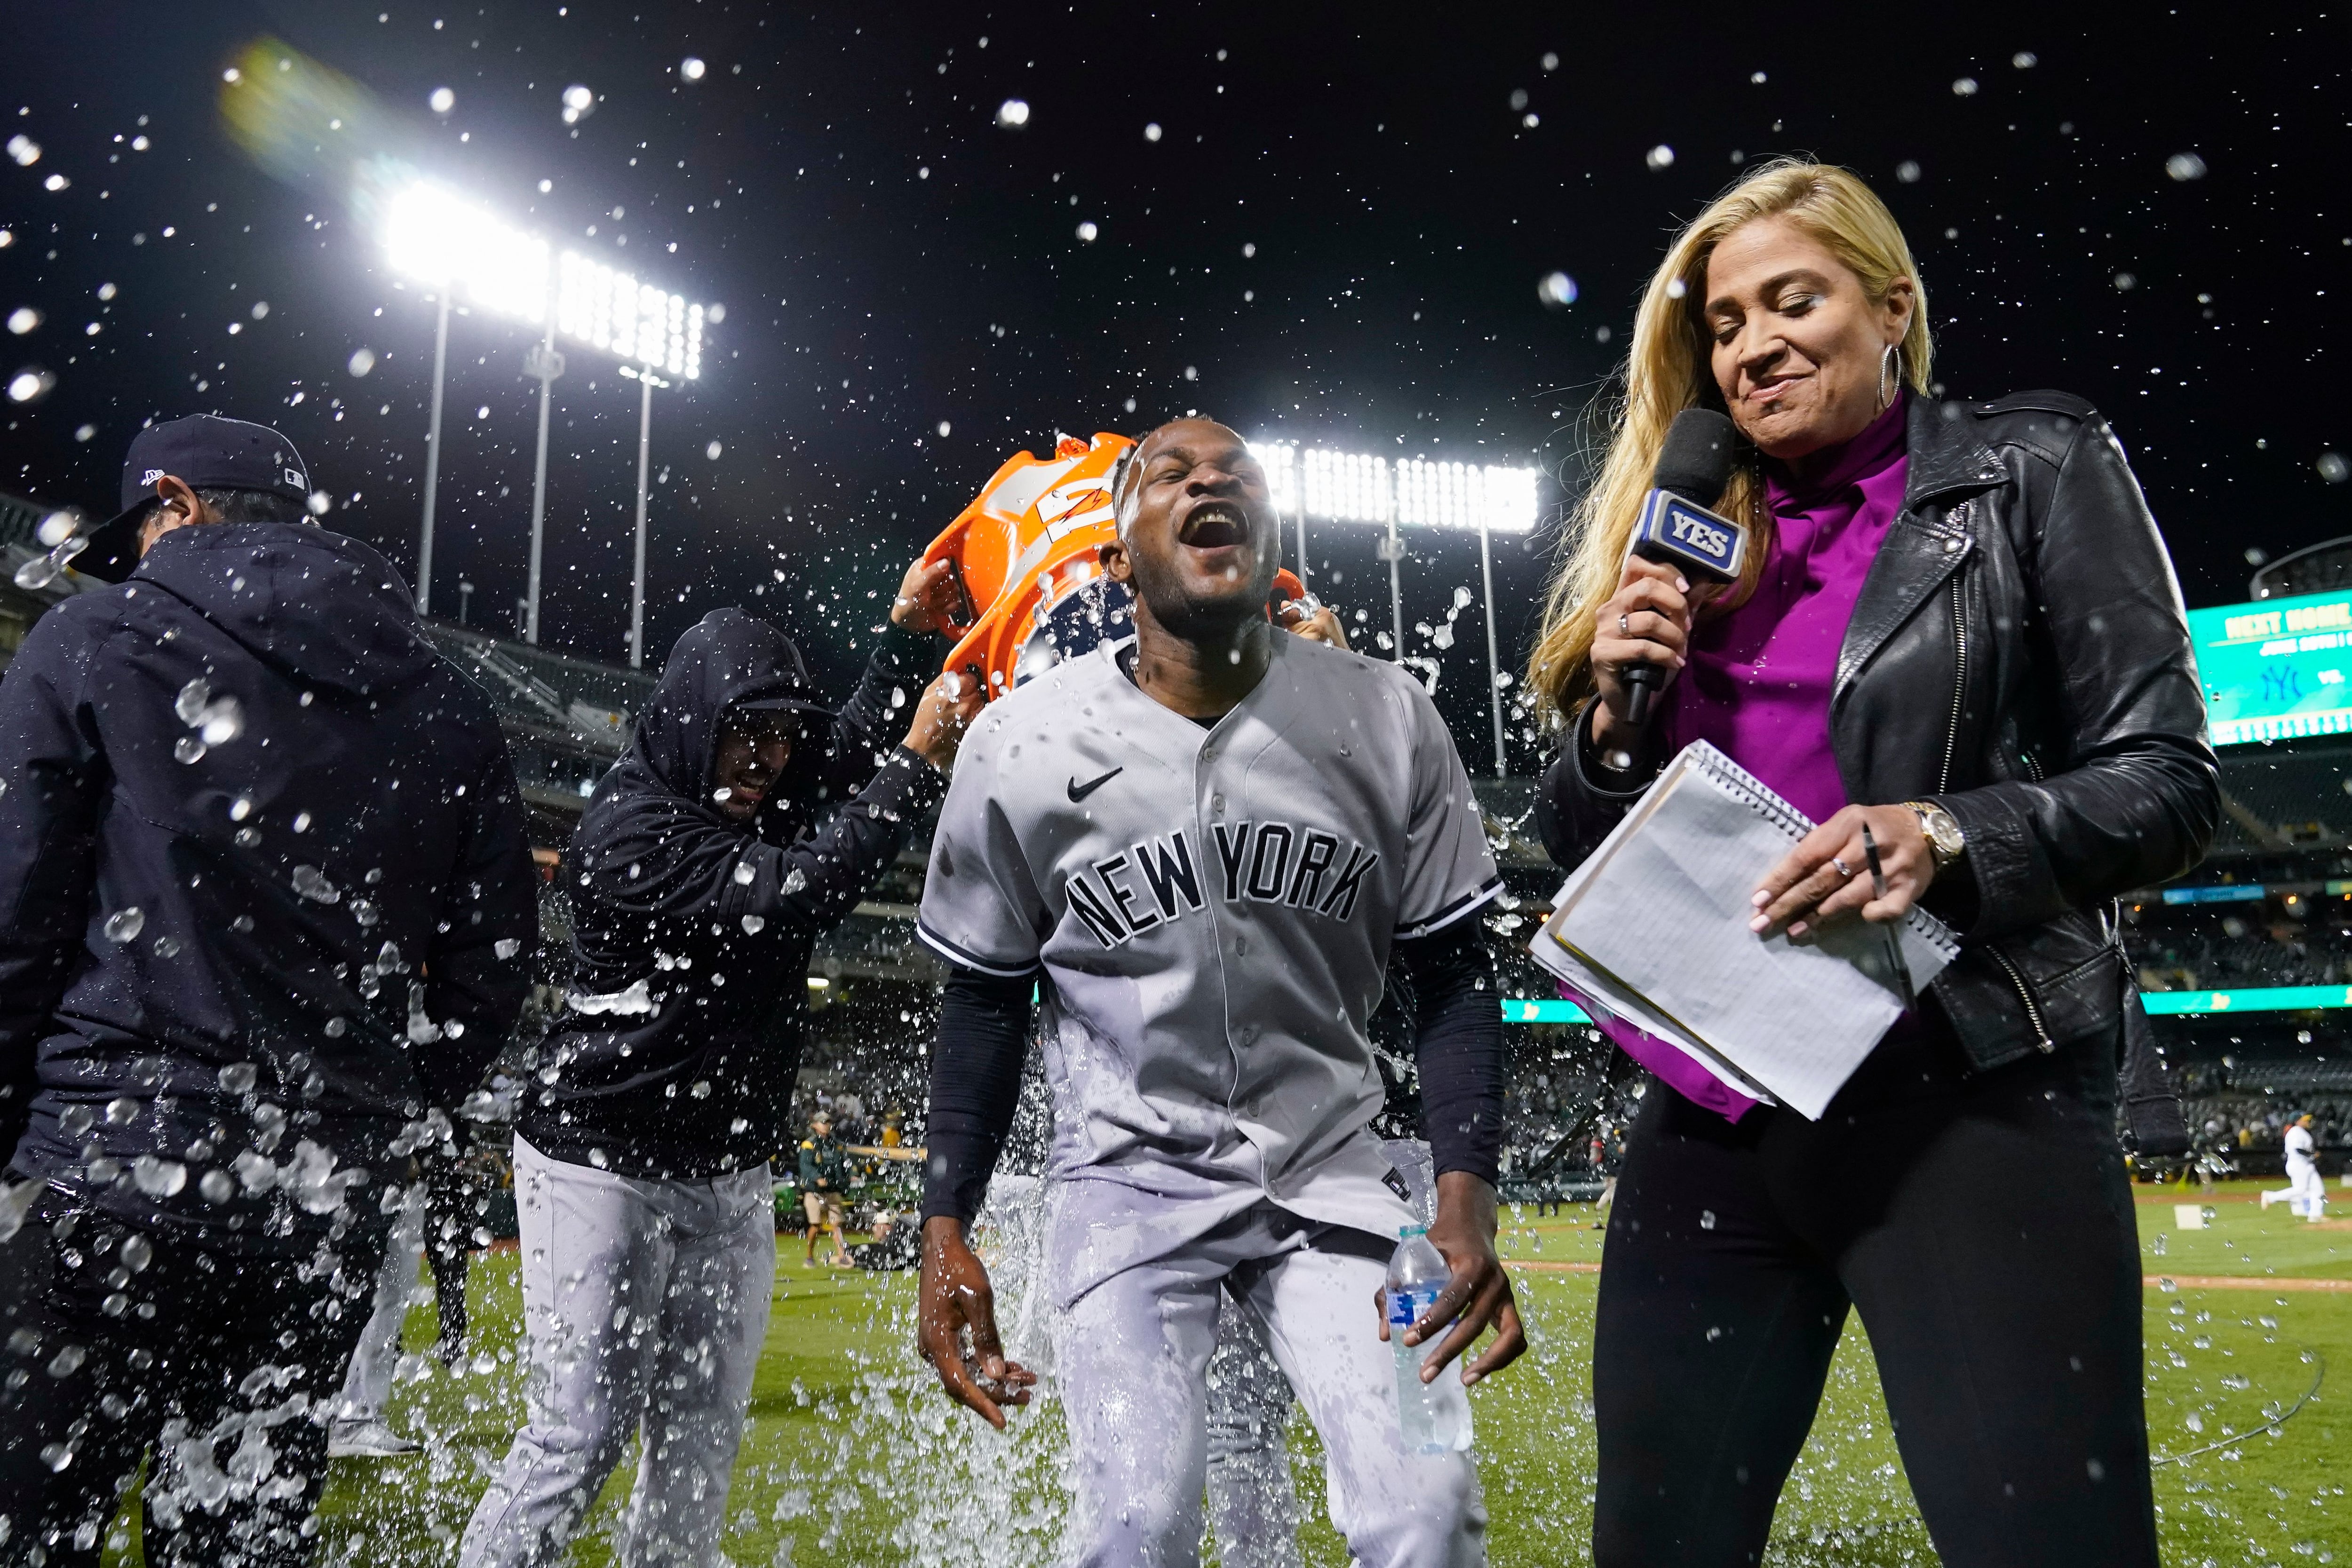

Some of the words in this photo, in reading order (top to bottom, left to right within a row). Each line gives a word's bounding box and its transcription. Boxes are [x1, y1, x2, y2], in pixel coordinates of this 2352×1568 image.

[1671, 511, 1729, 557] YES
[2225, 611, 2281, 639] NEXT
[1065, 828, 1205, 951] NEW
[1211, 820, 1380, 922] YORK
